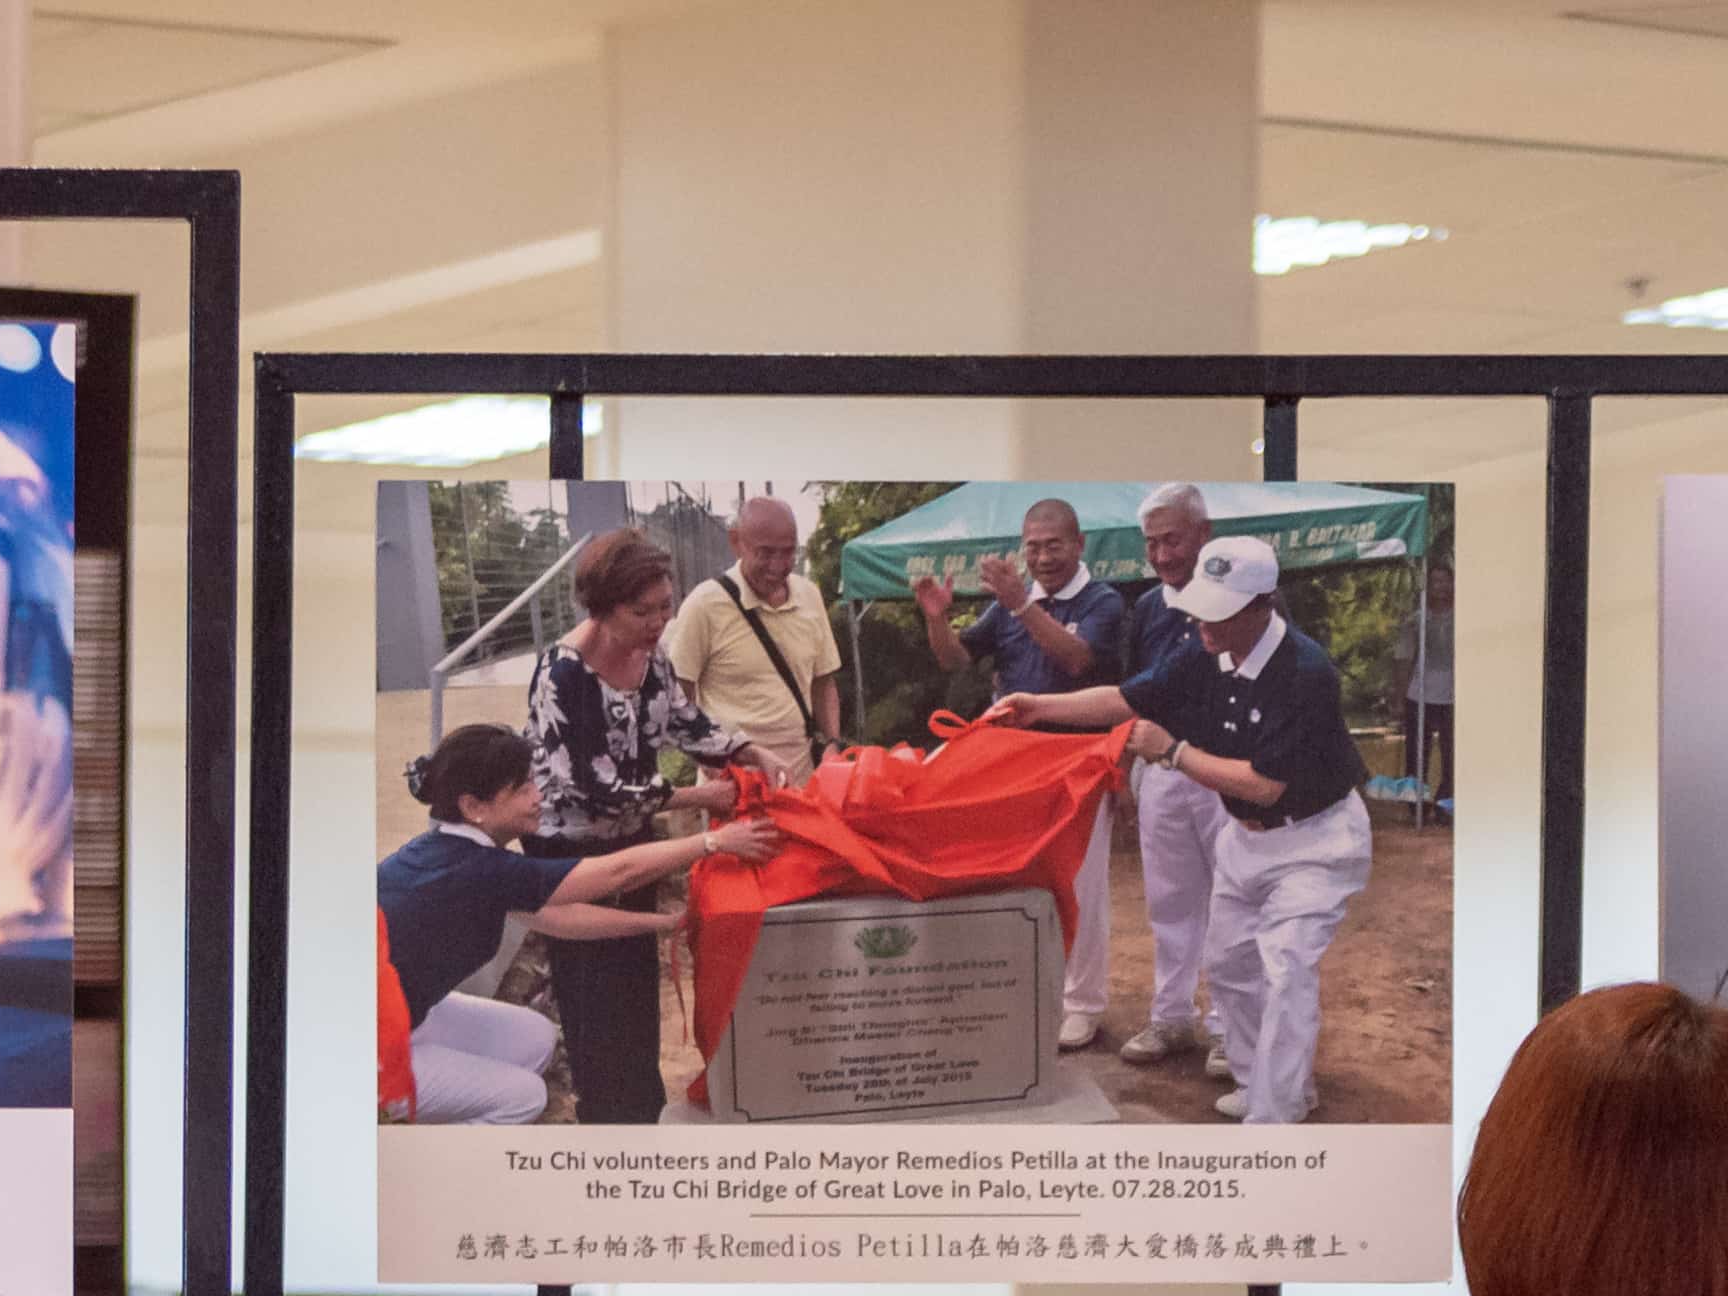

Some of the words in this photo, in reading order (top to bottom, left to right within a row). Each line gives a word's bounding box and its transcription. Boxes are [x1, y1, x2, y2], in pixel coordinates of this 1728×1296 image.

[504, 1150, 543, 1171] Tzu
[549, 1150, 586, 1171] Chi
[592, 1150, 710, 1171] volunteers
[716, 1150, 757, 1171] and
[764, 1150, 812, 1171] Palo
[819, 1151, 891, 1174] Mayor
[896, 1150, 1004, 1171] Remedios
[1010, 1150, 1079, 1170] Petilla
[1085, 1152, 1107, 1170] at
[1113, 1150, 1150, 1170] the
[1157, 1150, 1297, 1174] Inauguration
[1304, 1149, 1328, 1170] of
[585, 1179, 622, 1200] the
[627, 1179, 665, 1200] Tzu
[672, 1179, 709, 1200] Chi
[716, 1178, 788, 1204] Bridge
[794, 1179, 818, 1200] of
[823, 1179, 886, 1200] Great
[892, 1179, 944, 1200] Love
[951, 1179, 971, 1199] in
[978, 1179, 1032, 1201] Palo,
[1039, 1179, 1105, 1203] Leyte.
[1111, 1178, 1246, 1199] 07.28.2015.
